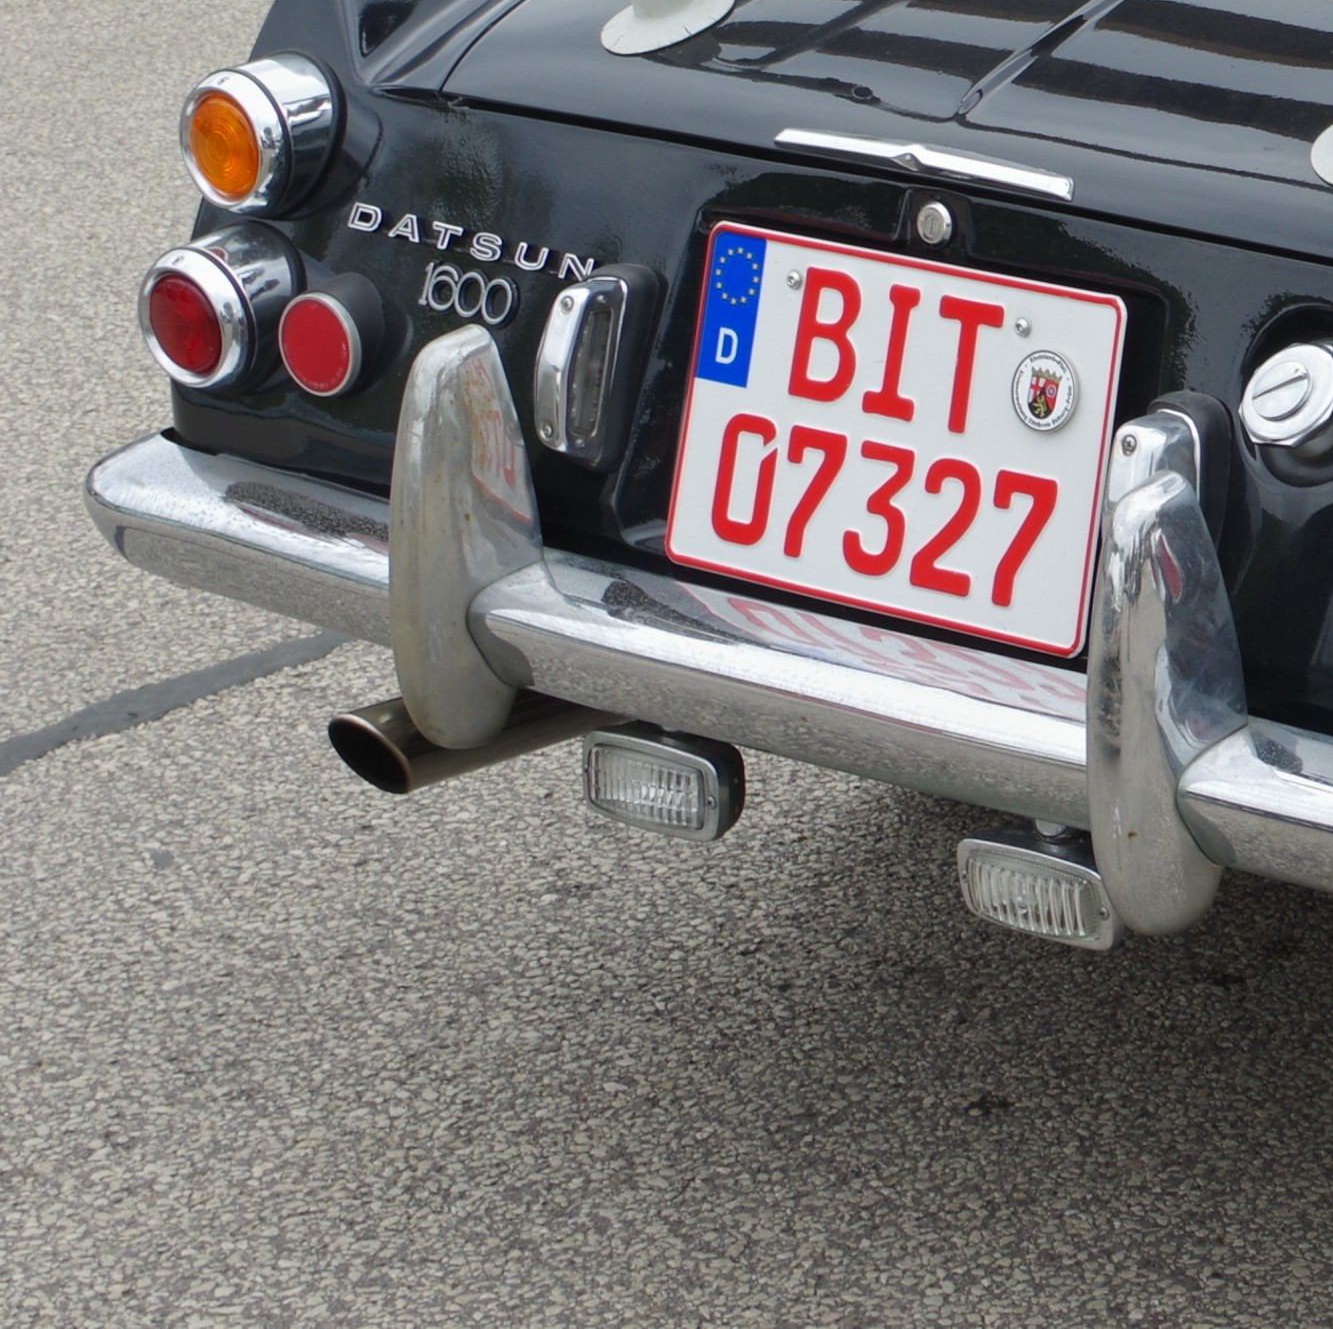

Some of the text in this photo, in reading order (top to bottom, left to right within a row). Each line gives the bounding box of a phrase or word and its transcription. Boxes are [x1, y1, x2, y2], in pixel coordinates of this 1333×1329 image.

[347, 202, 596, 282] DATSUN
[417, 261, 514, 326] 1600
[714, 327, 739, 365] D
[787, 266, 1006, 435] BIT
[710, 412, 1059, 608] 07327
